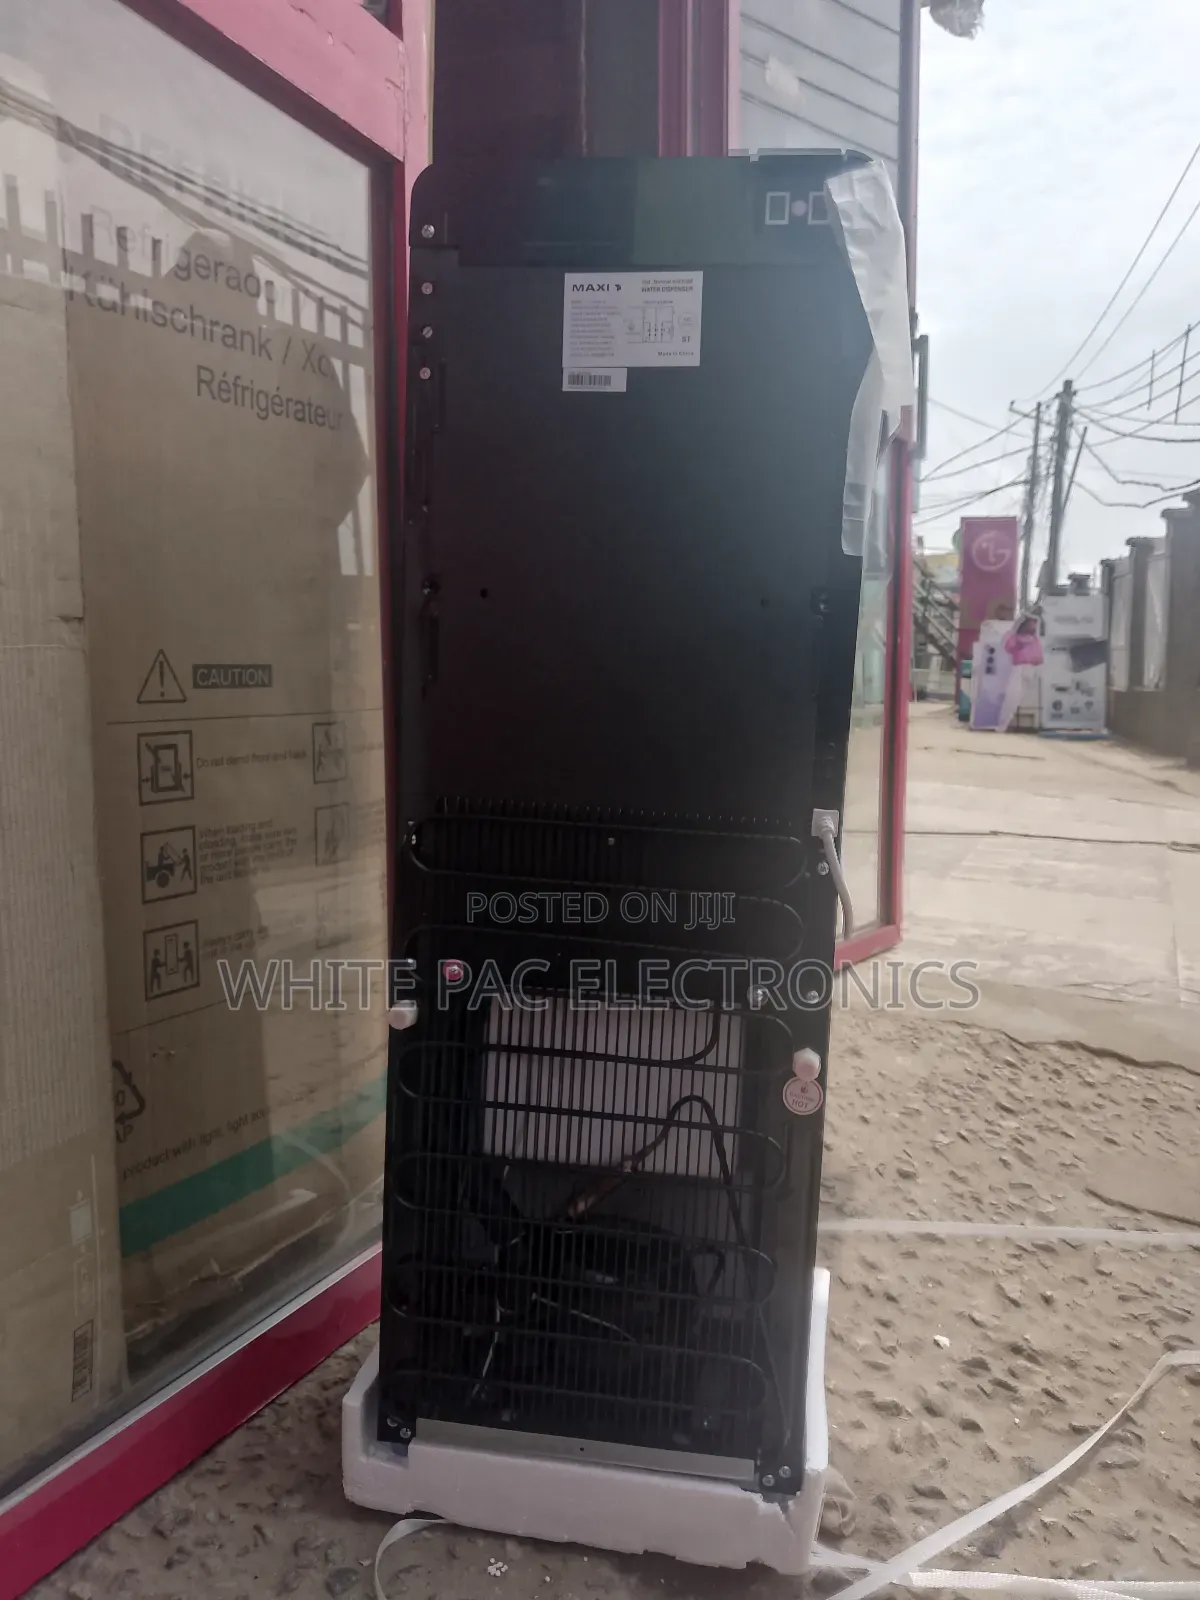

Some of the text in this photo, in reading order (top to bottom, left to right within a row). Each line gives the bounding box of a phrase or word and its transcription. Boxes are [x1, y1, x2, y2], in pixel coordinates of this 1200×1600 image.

[572, 284, 610, 292] MAXI
[661, 285, 694, 293] DISPENSER
[196, 364, 345, 431] Réfrigérateur
[972, 530, 1012, 572] LG
[196, 668, 270, 686] CAUTION
[792, 1099, 808, 1108] HOT
[123, 1148, 170, 1182] product
